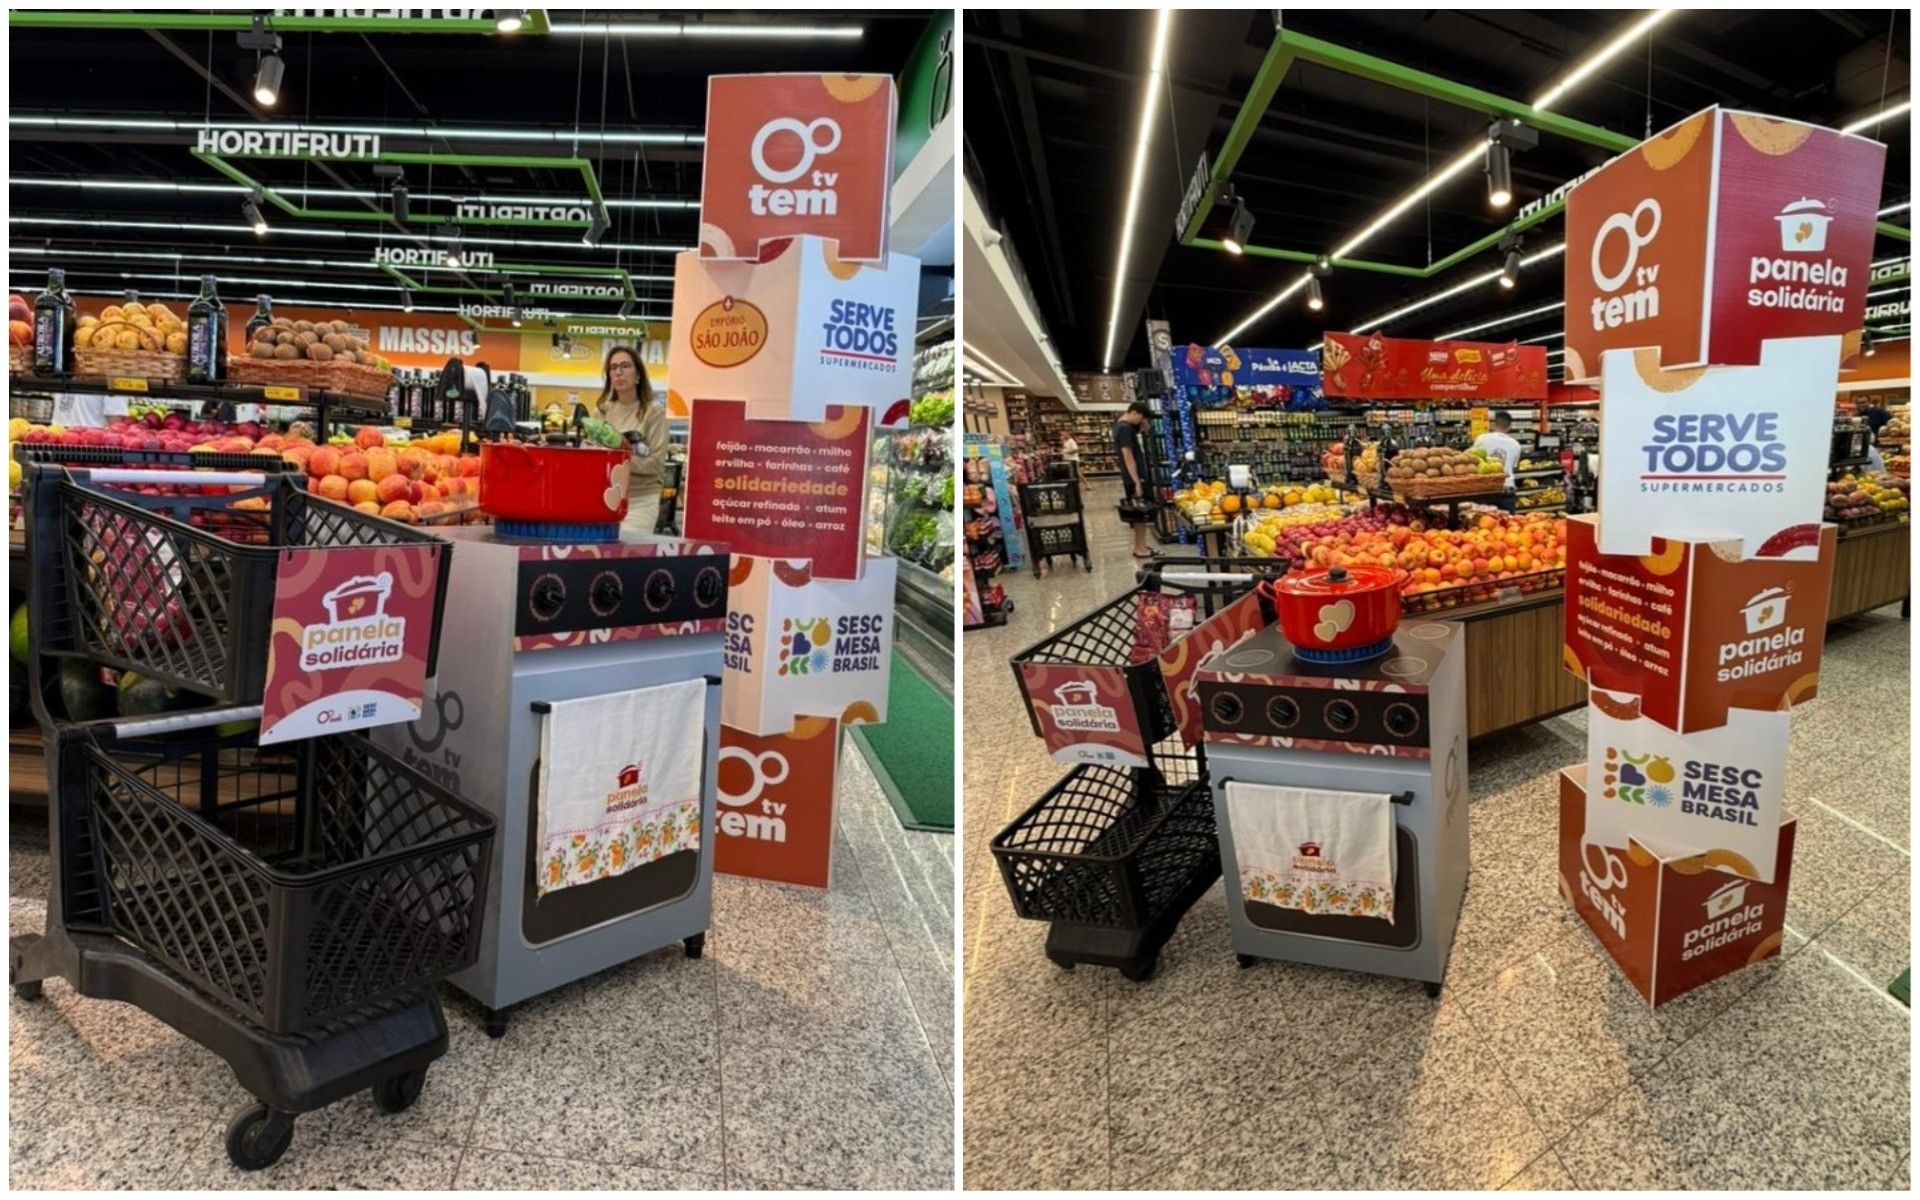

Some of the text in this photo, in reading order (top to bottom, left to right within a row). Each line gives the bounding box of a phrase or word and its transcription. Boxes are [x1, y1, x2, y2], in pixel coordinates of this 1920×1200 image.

[198, 130, 380, 158] HORTIFRUTI
[812, 170, 838, 187] tv
[748, 184, 838, 216] tem
[374, 247, 494, 268] HORTIFUTI
[1636, 264, 1660, 286] tv
[1750, 257, 1848, 287] panela
[1591, 286, 1660, 331] tem
[1747, 285, 1845, 313] solidária
[459, 304, 549, 321] HORTIFUTI
[829, 299, 895, 331] SERVE
[378, 326, 476, 357] MASSAS
[696, 327, 759, 349] SÃO JOÃO
[822, 323, 898, 356] TODOS
[819, 356, 897, 374] SUPERMERCADOS
[1651, 411, 1780, 444] SERVE
[716, 441, 852, 457] feijão macarrão milho
[1641, 442, 1788, 474] TODOS
[715, 458, 850, 474] ervilha farinhas café
[713, 475, 849, 497] solidariedade
[1640, 481, 1785, 494] SUPERMERCADOS
[712, 497, 847, 515] açúcar refinado atum
[711, 513, 846, 532] leite em pó óleo arroz
[1646, 582, 1675, 598] milho
[1578, 595, 1671, 639] solidariedade
[1650, 602, 1673, 616] café
[308, 619, 401, 650] panela
[836, 614, 883, 635] SESC
[305, 641, 400, 667] solidária
[834, 635, 881, 656] MESA
[1643, 642, 1670, 659] atum
[1718, 628, 1805, 665] panela
[832, 656, 880, 673] BRASIL
[1643, 659, 1669, 677] arroz
[1716, 648, 1803, 683] solidária
[1053, 706, 1113, 718] panela
[1057, 718, 1117, 729] solidária
[1683, 760, 1763, 789] SESC
[761, 798, 787, 817] tv
[1682, 780, 1760, 811] MESA
[1680, 800, 1758, 827] BRASIL
[715, 809, 787, 843] em
[1579, 870, 1627, 940] tem
[1682, 902, 1764, 949] panela
[1681, 920, 1763, 962] solidária
